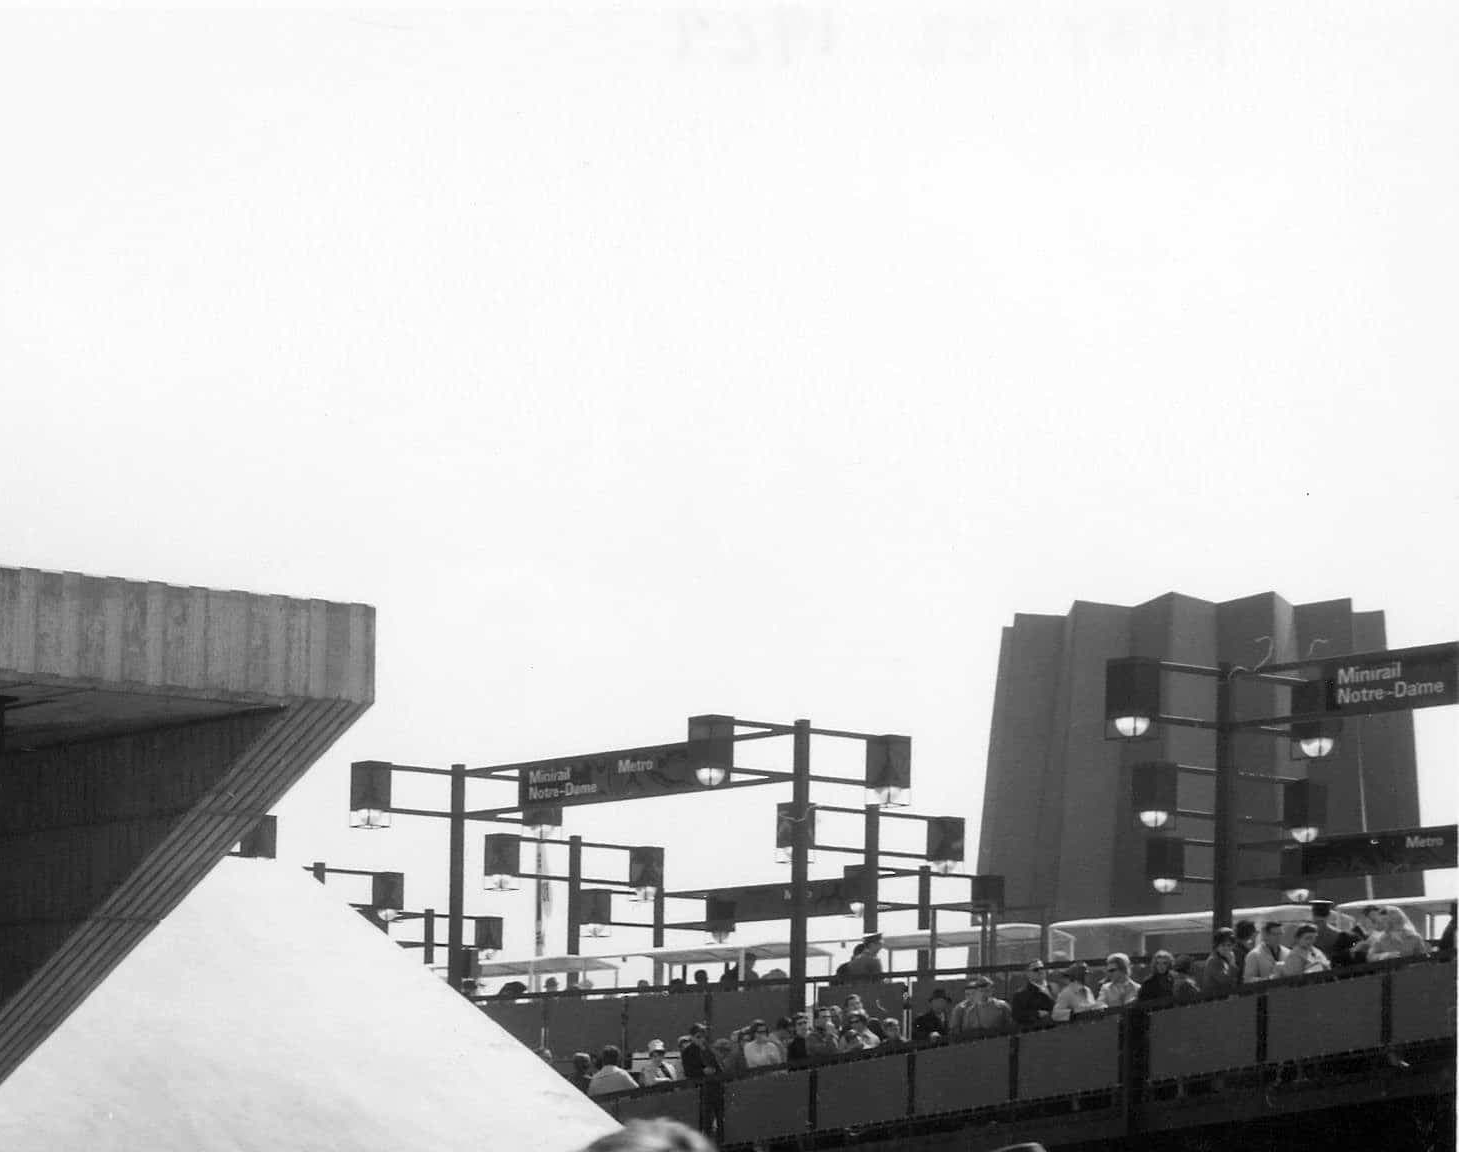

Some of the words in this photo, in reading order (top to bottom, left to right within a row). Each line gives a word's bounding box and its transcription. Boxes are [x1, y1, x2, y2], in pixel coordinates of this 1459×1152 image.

[1338, 661, 1401, 684] Minirail
[1338, 682, 1444, 704] Notre-Dame
[618, 759, 653, 773] Metro
[529, 767, 571, 784] Minirail
[529, 782, 597, 800] Notre-Dame
[1405, 835, 1445, 848] Metro
